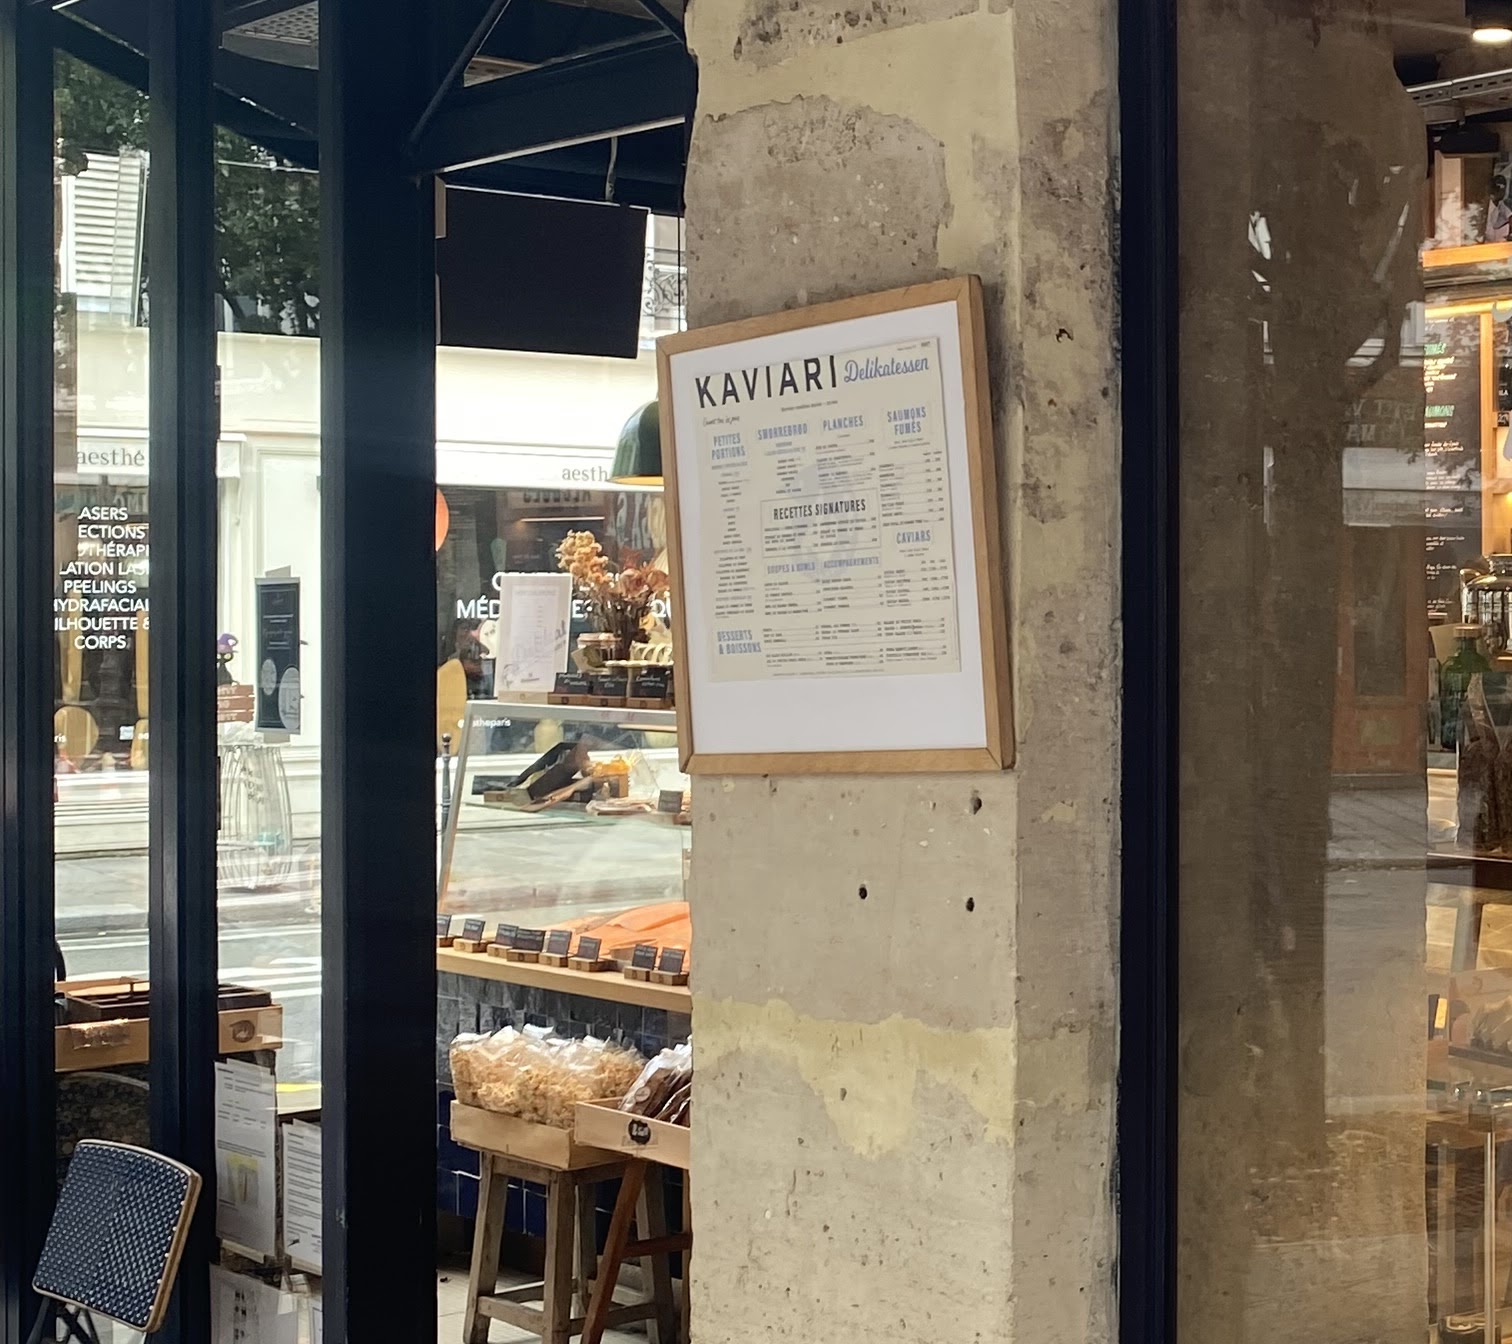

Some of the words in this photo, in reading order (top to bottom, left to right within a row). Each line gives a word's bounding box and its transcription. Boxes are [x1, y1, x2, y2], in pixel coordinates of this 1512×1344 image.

[695, 355, 837, 409] KAVIARI
[843, 356, 930, 383] Delikatessen
[887, 406, 927, 423] SAUMONS
[822, 415, 864, 432] PLANCHES
[711, 445, 746, 461] PORTIONS
[77, 506, 129, 522] ASERS
[773, 504, 813, 521] RECETTES
[814, 499, 867, 517] SIGNATURES
[896, 529, 932, 545] CAVIARS
[63, 580, 138, 594] PEELINGS
[74, 635, 128, 650] CORPS
[717, 629, 753, 642] DESSERTS
[726, 641, 762, 655] BOISSONS
